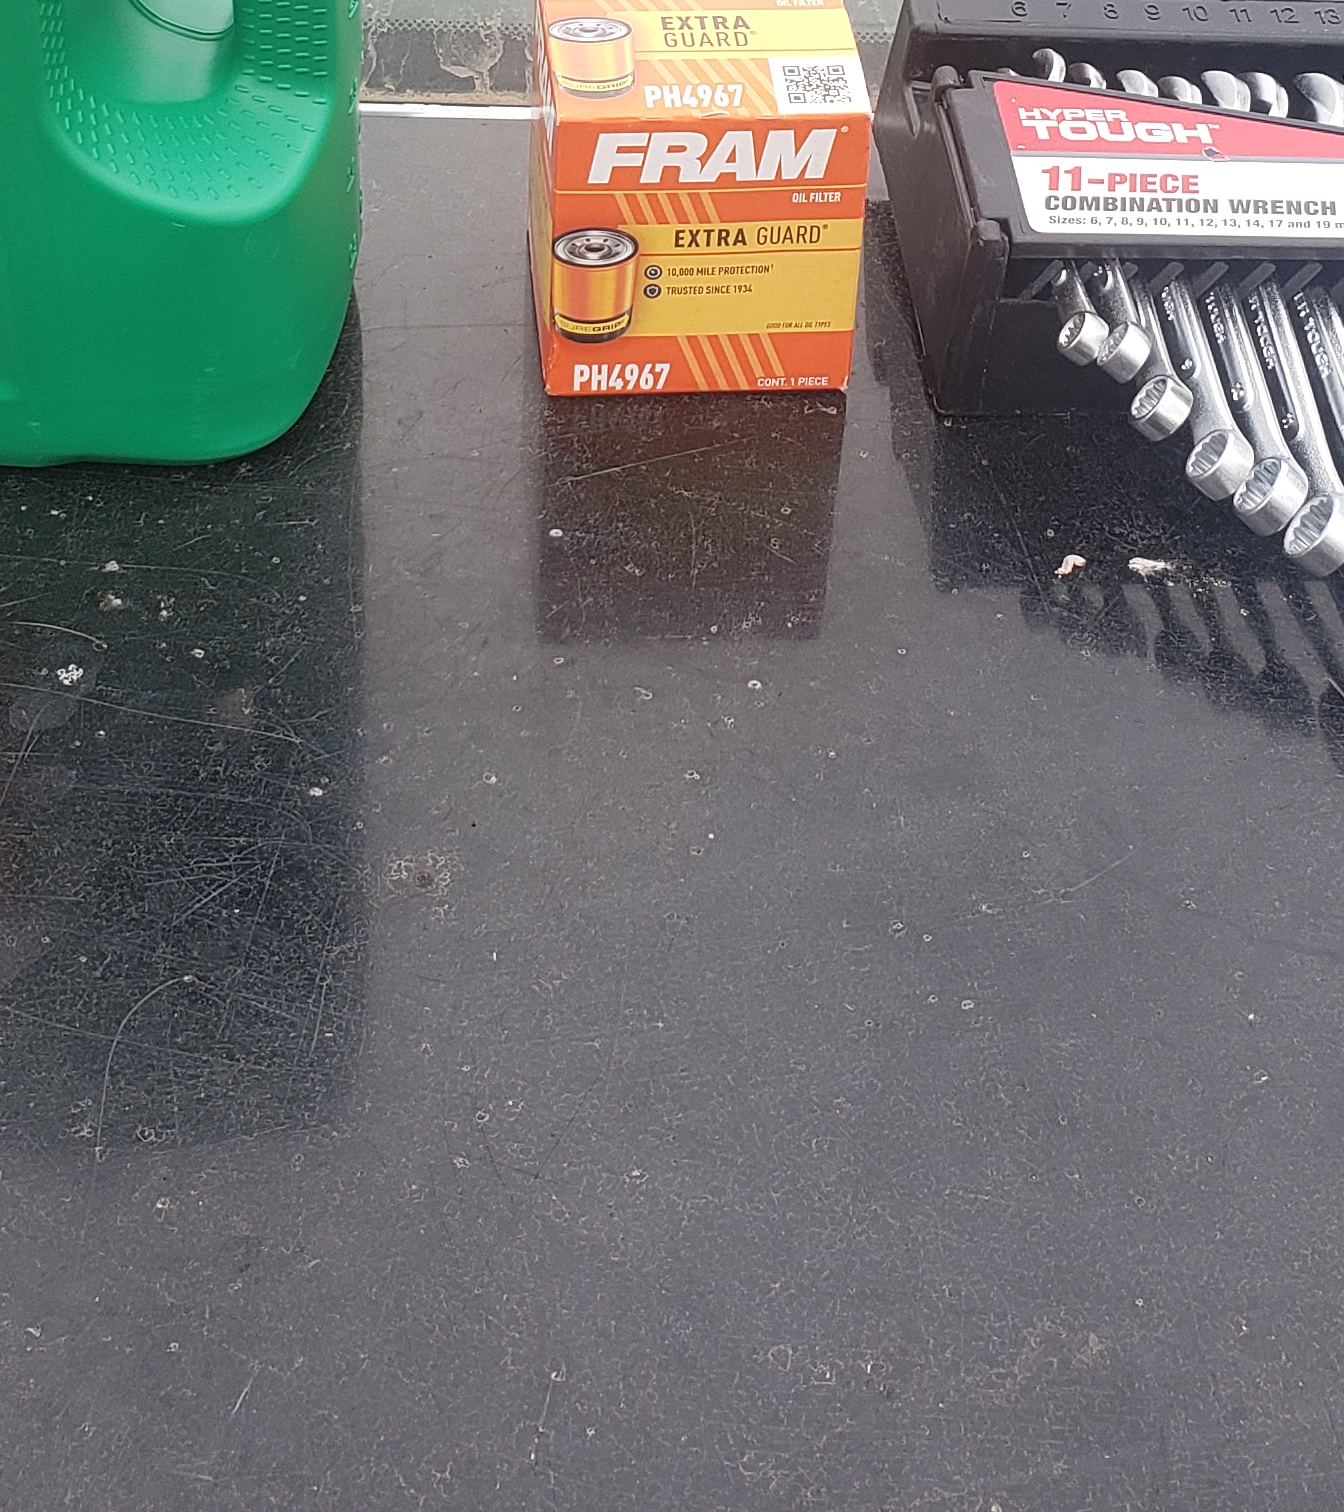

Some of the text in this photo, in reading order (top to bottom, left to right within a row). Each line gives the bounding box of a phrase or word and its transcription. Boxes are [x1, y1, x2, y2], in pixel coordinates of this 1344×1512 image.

[661, 15, 751, 30] EXTRA
[1012, 1, 1028, 17] 6
[1056, 2, 1071, 18] 7
[1103, 3, 1119, 19] 8
[1144, 4, 1160, 20] 9
[1182, 5, 1208, 21] 10
[1229, 8, 1252, 23] 11
[1270, 7, 1300, 24] 12
[1314, 8, 1341, 25] 13
[664, 31, 749, 48] GUARD
[643, 83, 745, 109] PH4967
[1017, 107, 1129, 122] HYPER
[1021, 120, 1213, 144] TOUGH
[587, 128, 838, 184] FRAM
[1041, 165, 1200, 194] 11-PIECE
[791, 191, 841, 203] OIL FILTER
[1044, 194, 1219, 214] COMBINATION
[1228, 199, 1337, 216] WRENCH
[1048, 215, 1086, 225] Sizes:
[1090, 216, 1102, 226] 6,
[1106, 216, 1117, 227] 7,
[1120, 216, 1133, 227] 8,
[1136, 216, 1148, 227] 9,
[1152, 217, 1171, 228] 10,
[1175, 218, 1195, 228] 11,
[1199, 218, 1218, 228] 12,
[1221, 218, 1241, 229] 13,
[1245, 219, 1264, 229] 14,
[1268, 219, 1284, 229] 17
[1287, 220, 1311, 229] and
[1315, 220, 1331, 230] 19
[674, 225, 821, 248] EXTRA GUARD
[666, 264, 770, 278] 10,000 MILE PROTECTION
[666, 284, 753, 296] TRUSTED SINCE 1934
[573, 362, 671, 392] PH4967
[757, 376, 829, 387] CONT. 1 PIECE
